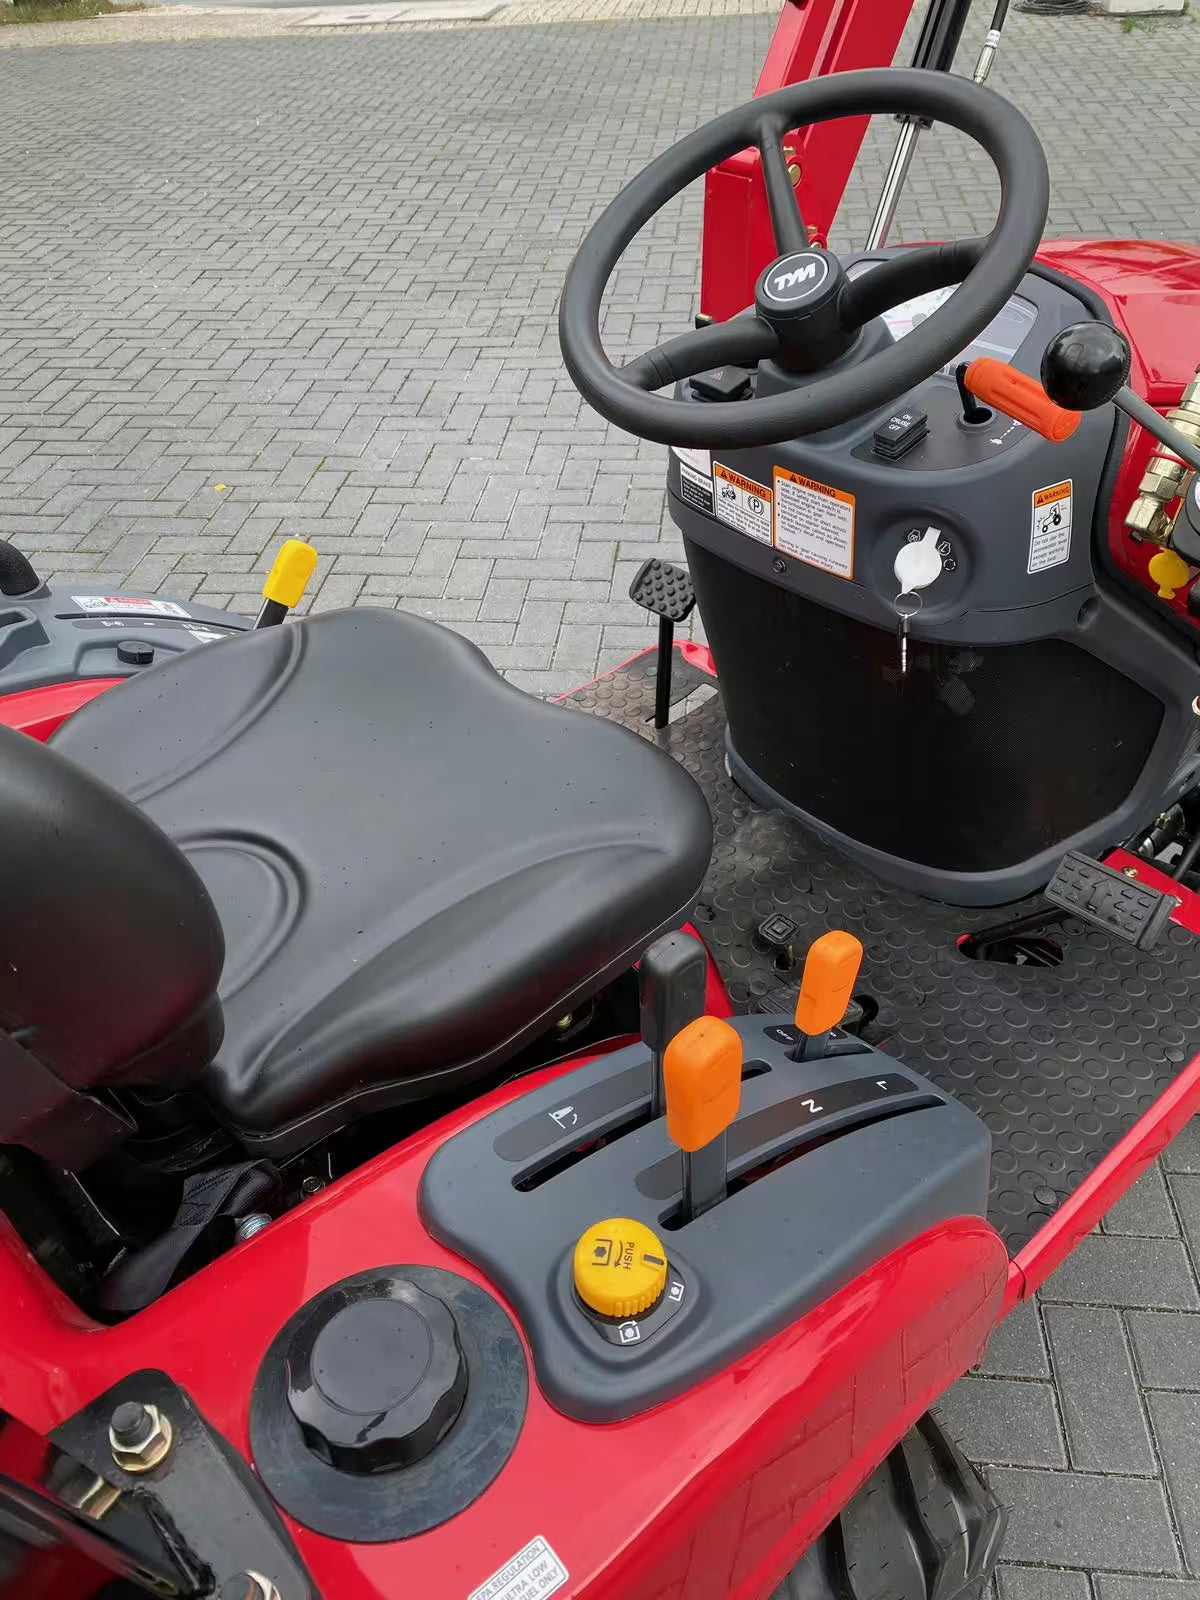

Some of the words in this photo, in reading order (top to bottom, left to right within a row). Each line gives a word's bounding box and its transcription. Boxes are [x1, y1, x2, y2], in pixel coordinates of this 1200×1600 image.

[774, 262, 816, 290] TYM
[890, 417, 910, 427] CRUISE
[728, 473, 766, 498] WARNING
[798, 476, 836, 498] WARNING
[1044, 486, 1070, 501] WARNING
[776, 1029, 794, 1041] OFF
[801, 1099, 824, 1113] N
[623, 1242, 635, 1270] PUSH
[491, 1544, 540, 1589] REGULATION
[528, 1560, 548, 1581] LOW
[538, 1566, 558, 1589] ONLY
